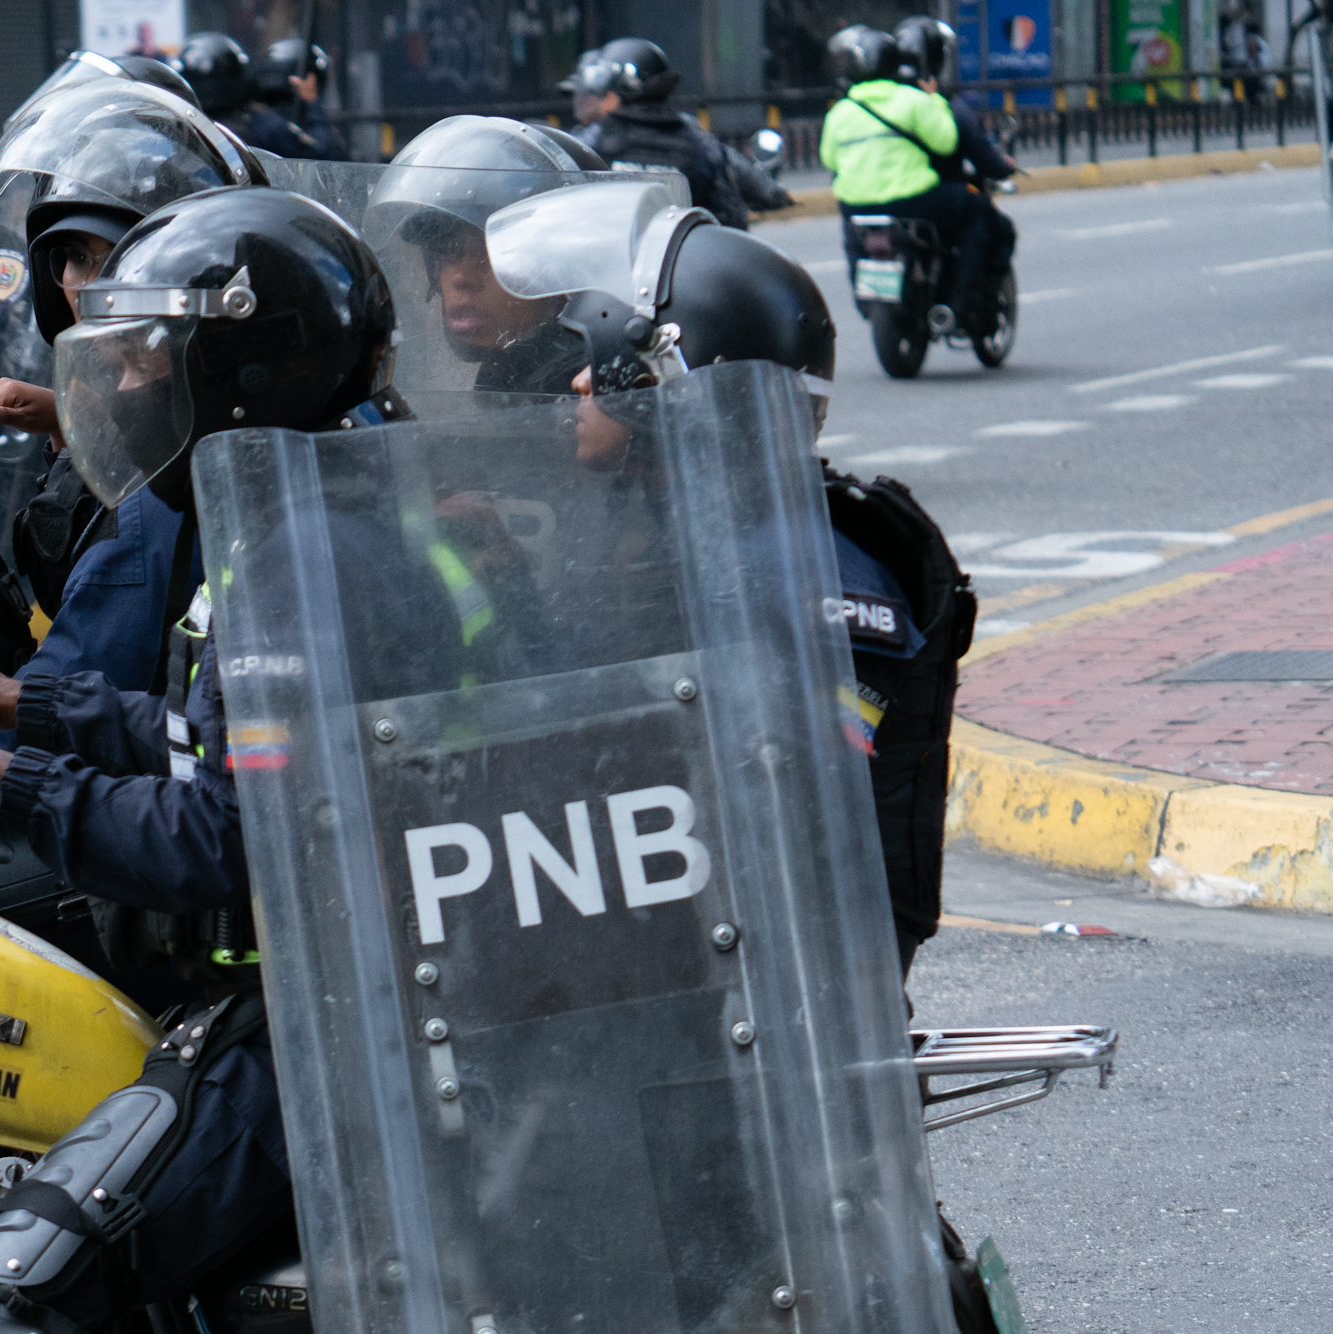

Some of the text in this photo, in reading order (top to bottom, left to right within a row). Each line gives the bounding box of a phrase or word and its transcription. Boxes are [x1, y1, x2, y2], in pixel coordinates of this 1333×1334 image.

[822, 597, 897, 634] CPNB
[404, 784, 712, 946] PNB
[239, 1285, 308, 1311] GN12
